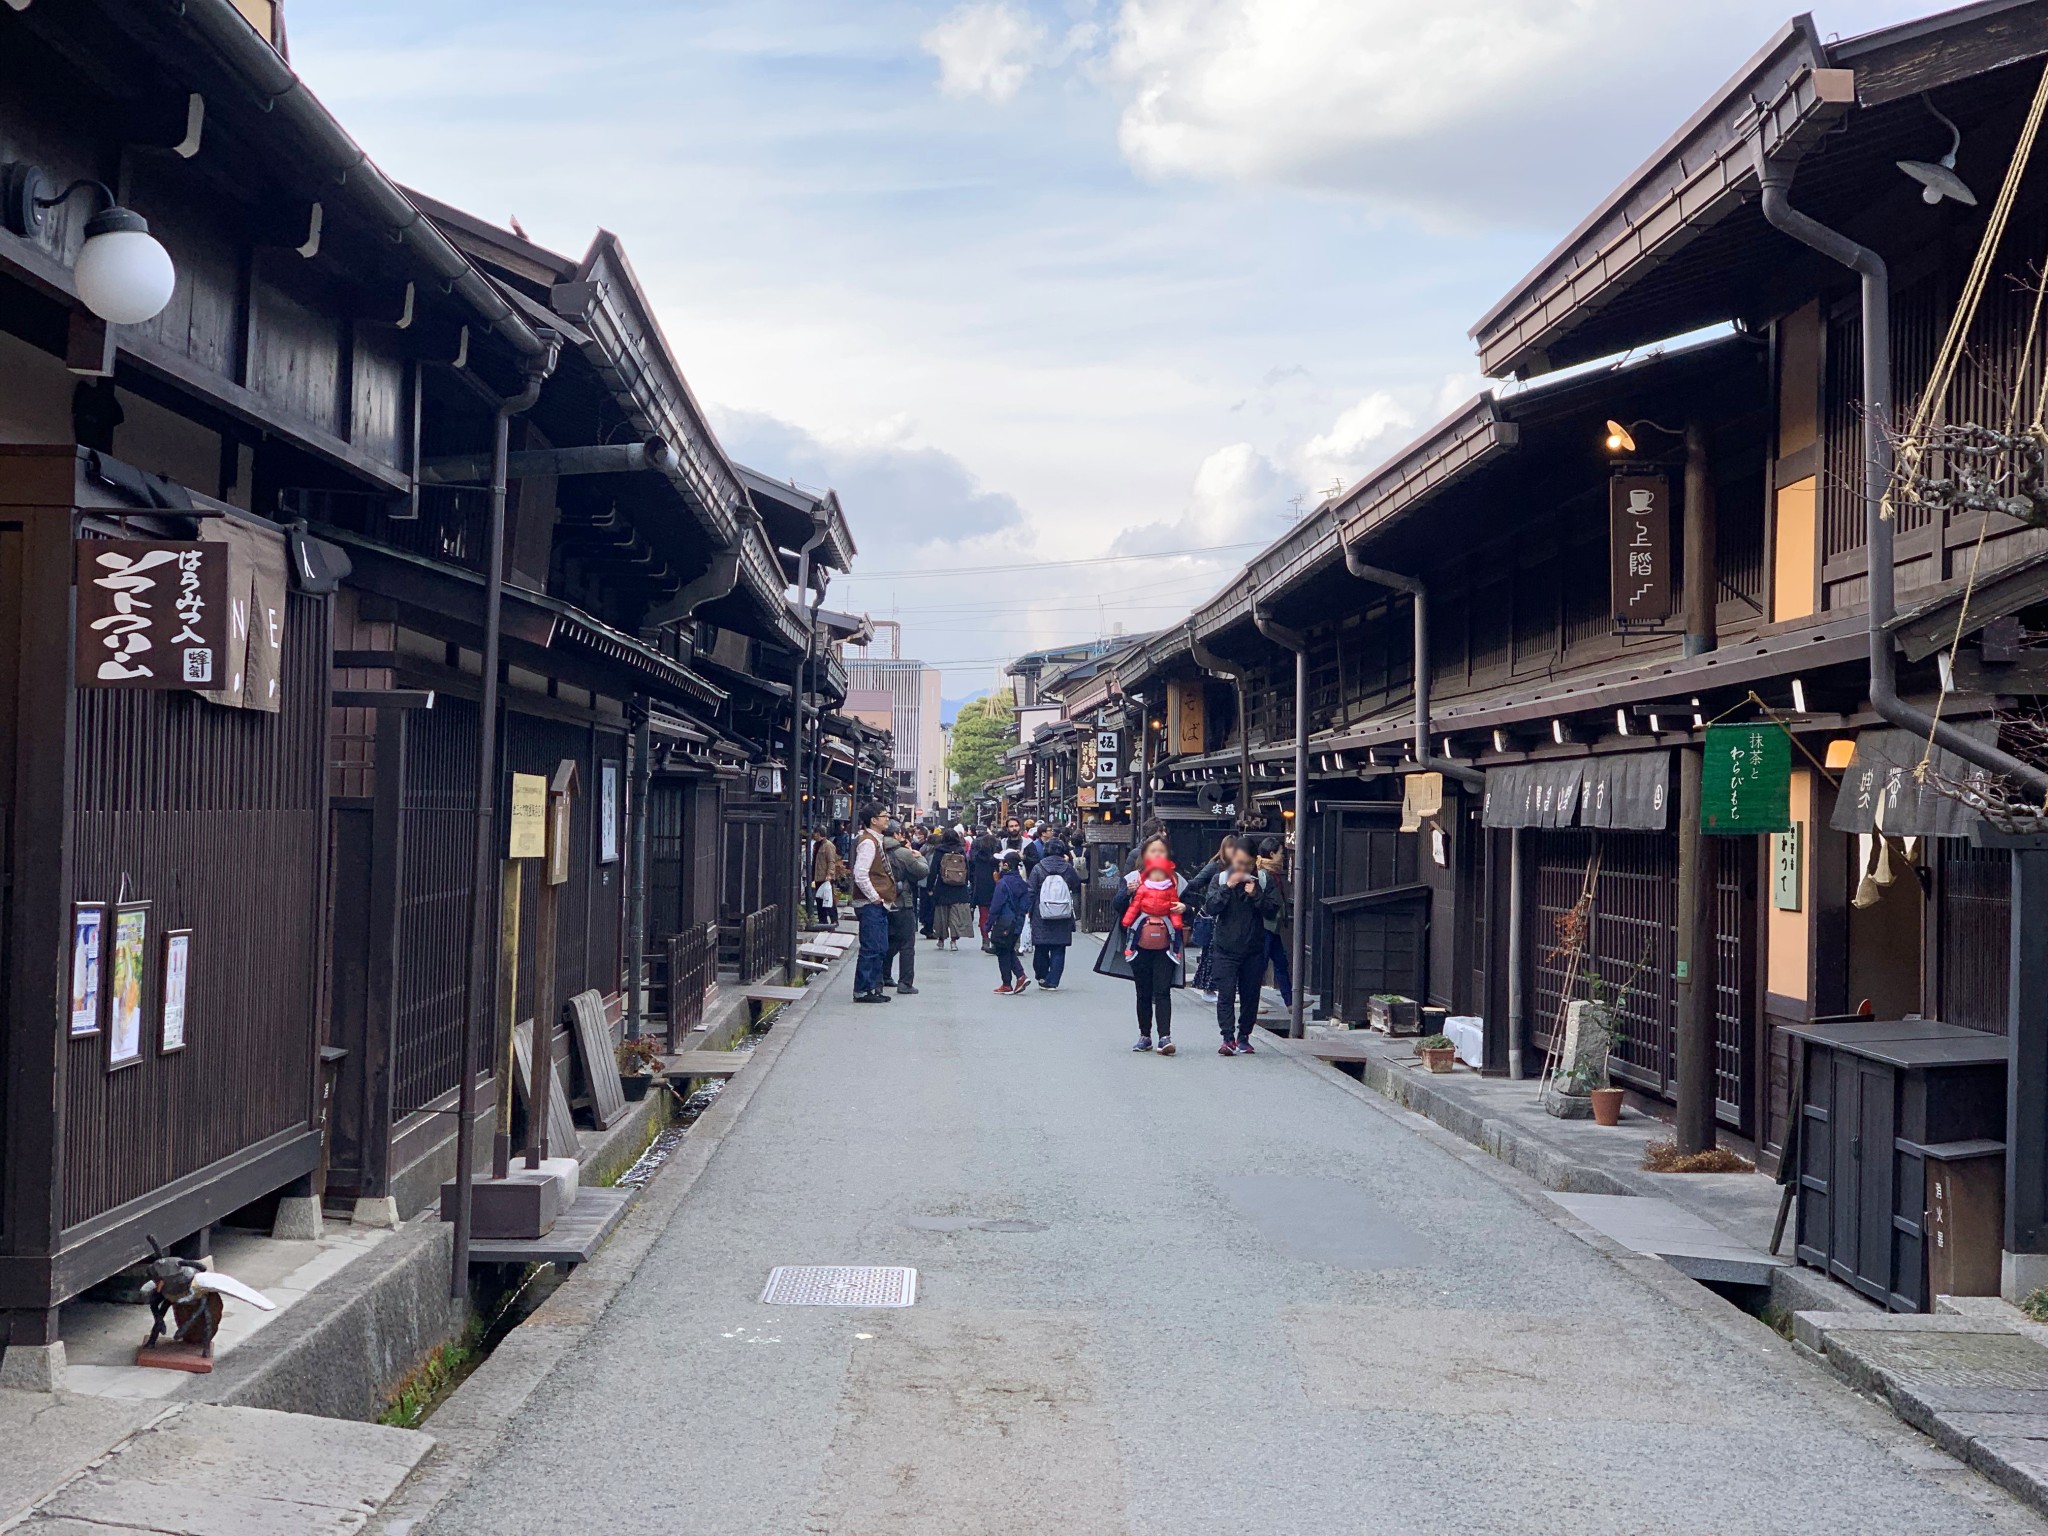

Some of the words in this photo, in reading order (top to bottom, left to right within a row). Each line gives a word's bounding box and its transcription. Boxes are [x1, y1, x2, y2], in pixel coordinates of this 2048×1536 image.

[1182, 694, 1200, 743] そば
[1749, 732, 1764, 779] 抹茶と
[1730, 746, 1745, 820] わらびもち
